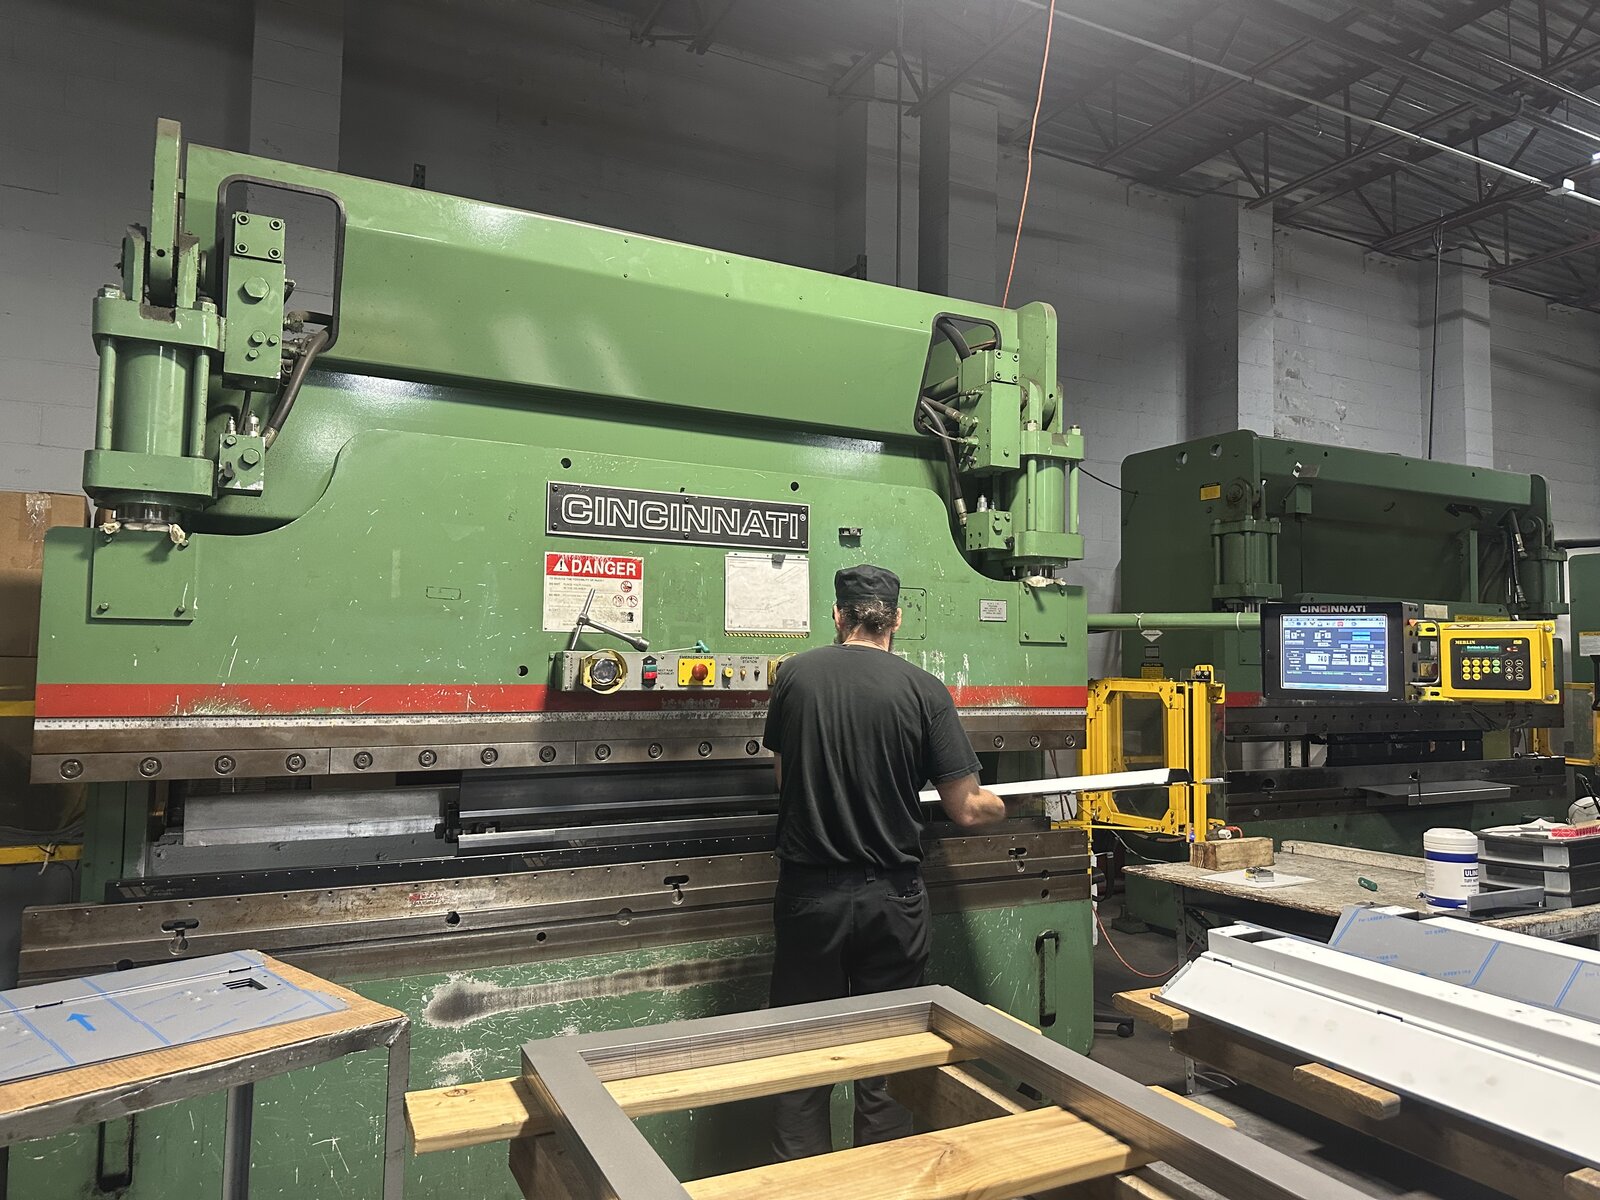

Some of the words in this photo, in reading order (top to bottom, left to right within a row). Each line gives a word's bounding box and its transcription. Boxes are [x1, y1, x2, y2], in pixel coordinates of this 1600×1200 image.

[561, 493, 799, 541] CINCINNATI
[571, 559, 636, 576] DANGER
[1300, 605, 1366, 613] CINCINNATI
